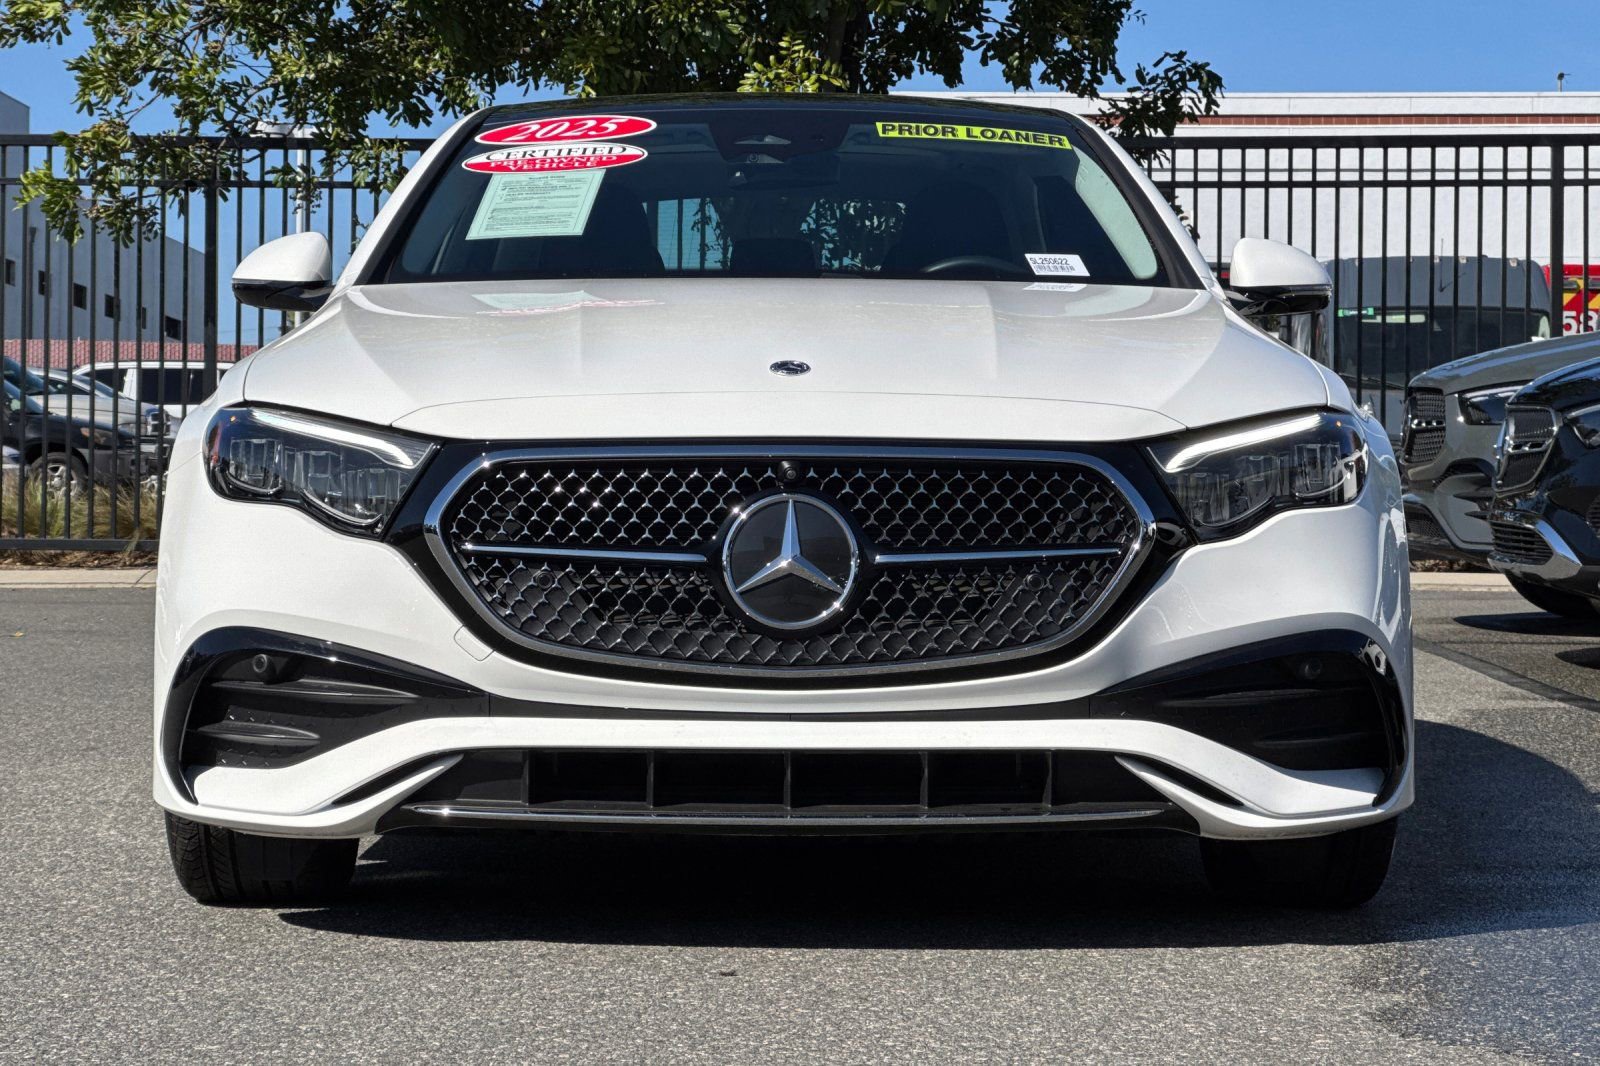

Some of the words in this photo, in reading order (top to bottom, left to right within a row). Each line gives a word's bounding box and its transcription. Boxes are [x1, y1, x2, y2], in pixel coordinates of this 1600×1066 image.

[500, 118, 628, 142] 2025
[880, 124, 957, 137] PRIOR
[965, 127, 1066, 146] LOANER
[485, 146, 626, 162] CERTIFIED
[490, 155, 617, 168] PRE-OWNED
[508, 160, 597, 171] VEHICLE
